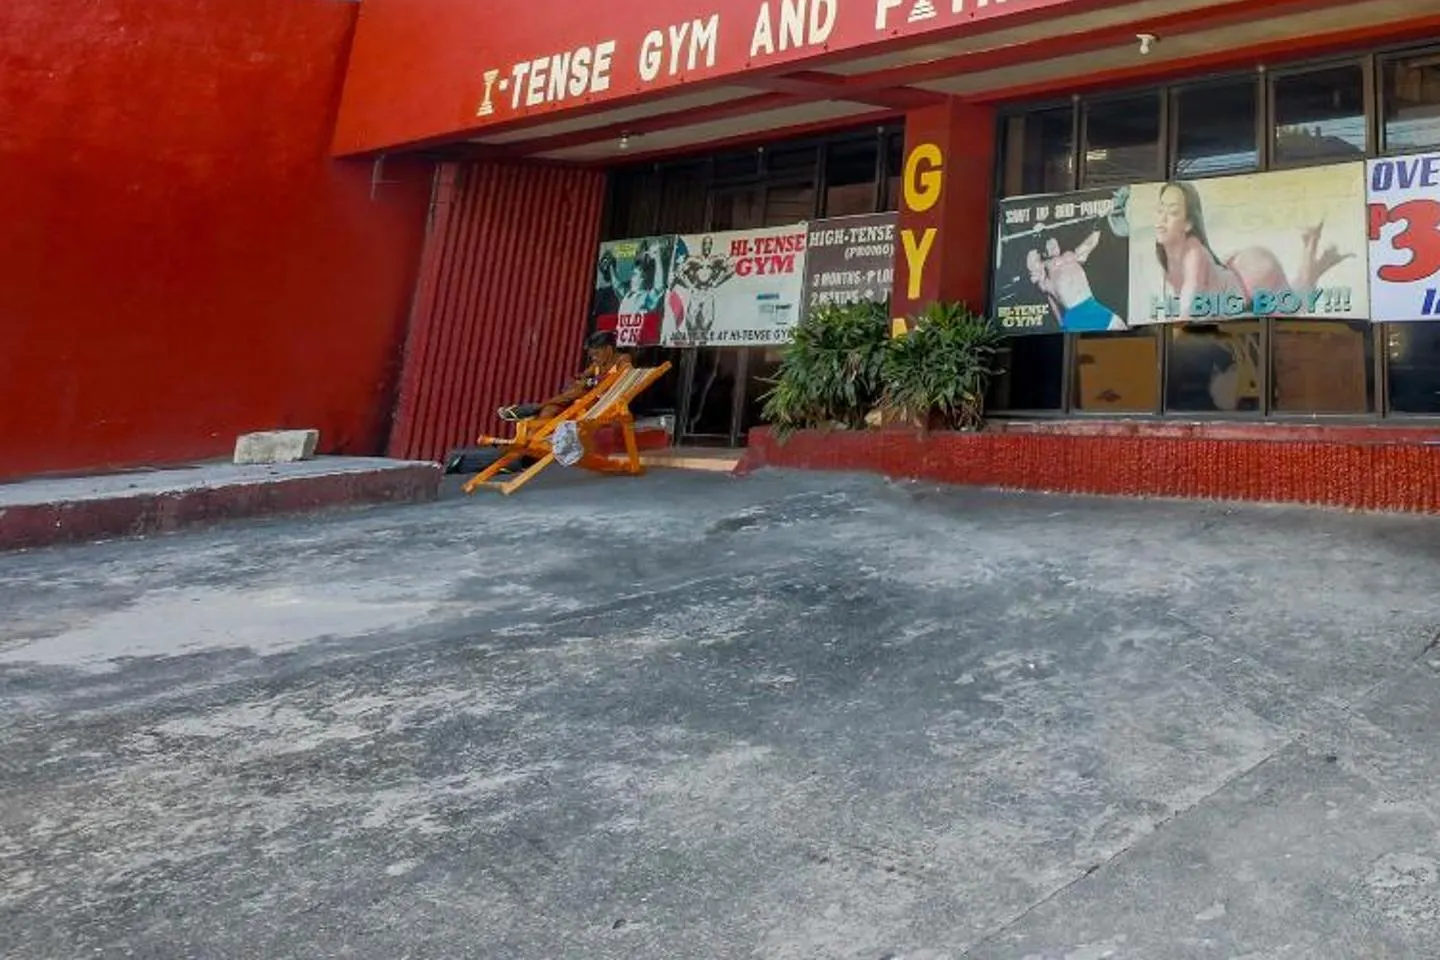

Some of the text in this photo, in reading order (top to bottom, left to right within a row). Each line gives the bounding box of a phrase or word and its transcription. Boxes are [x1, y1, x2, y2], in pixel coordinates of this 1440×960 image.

[638, 13, 720, 82] GYM
[730, 233, 807, 256] HI-TENSE
[808, 224, 896, 247] HIGH-TENSE
[892, 143, 944, 339] GY
[735, 254, 796, 277] GYM
[1190, 292, 1244, 318] BIG
[1002, 314, 1044, 327] GYM
